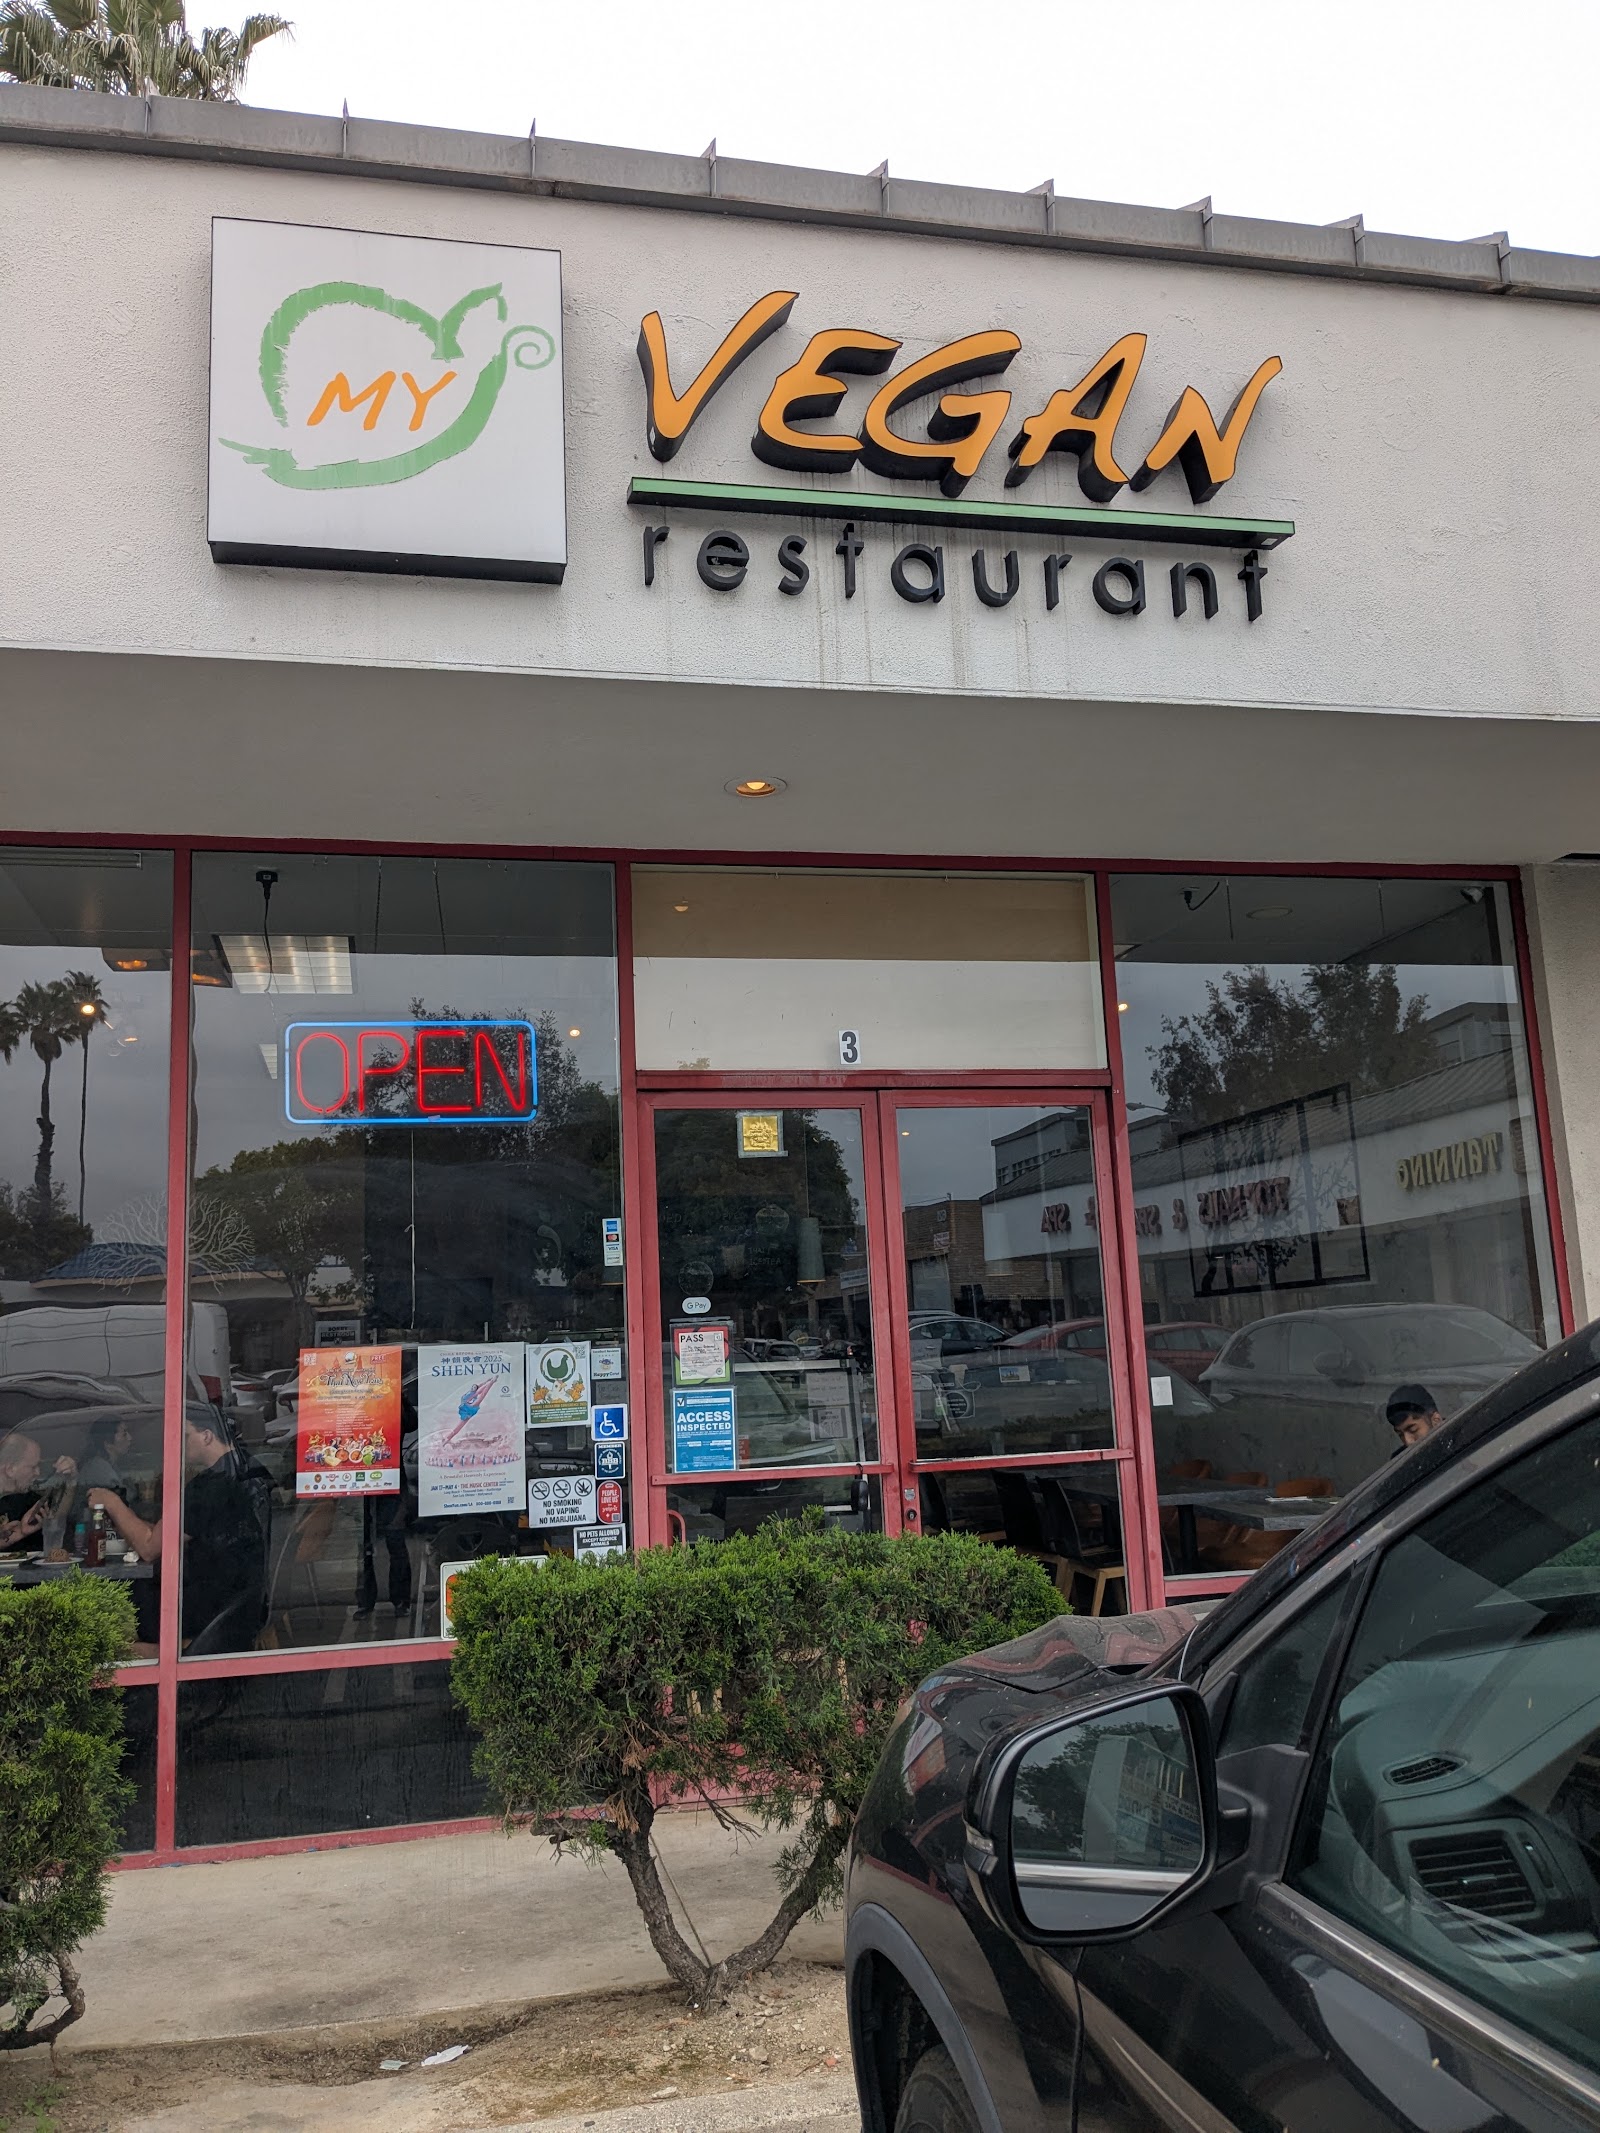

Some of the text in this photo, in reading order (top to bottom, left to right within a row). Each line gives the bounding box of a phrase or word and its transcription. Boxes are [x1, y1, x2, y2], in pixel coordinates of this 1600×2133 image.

[307, 370, 458, 432] MY
[637, 290, 1283, 505] VEGAN
[644, 523, 1267, 622] restaurant
[841, 1031, 859, 1063] 3
[296, 1029, 527, 1114] OPEN
[694, 1302, 707, 1310] Pay
[680, 1333, 704, 1343] PASS
[483, 1355, 503, 1363] 2025
[431, 1363, 511, 1377] SHEN YUN
[677, 1411, 731, 1423] ACCESS
[676, 1422, 732, 1432] INSPECTED
[601, 1489, 618, 1497] PEOPLE
[542, 1498, 582, 1508] NO SMOKING
[601, 1496, 612, 1504] LOVE
[545, 1507, 580, 1516] NO VAPING
[539, 1514, 587, 1525] NO MARIJUANA
